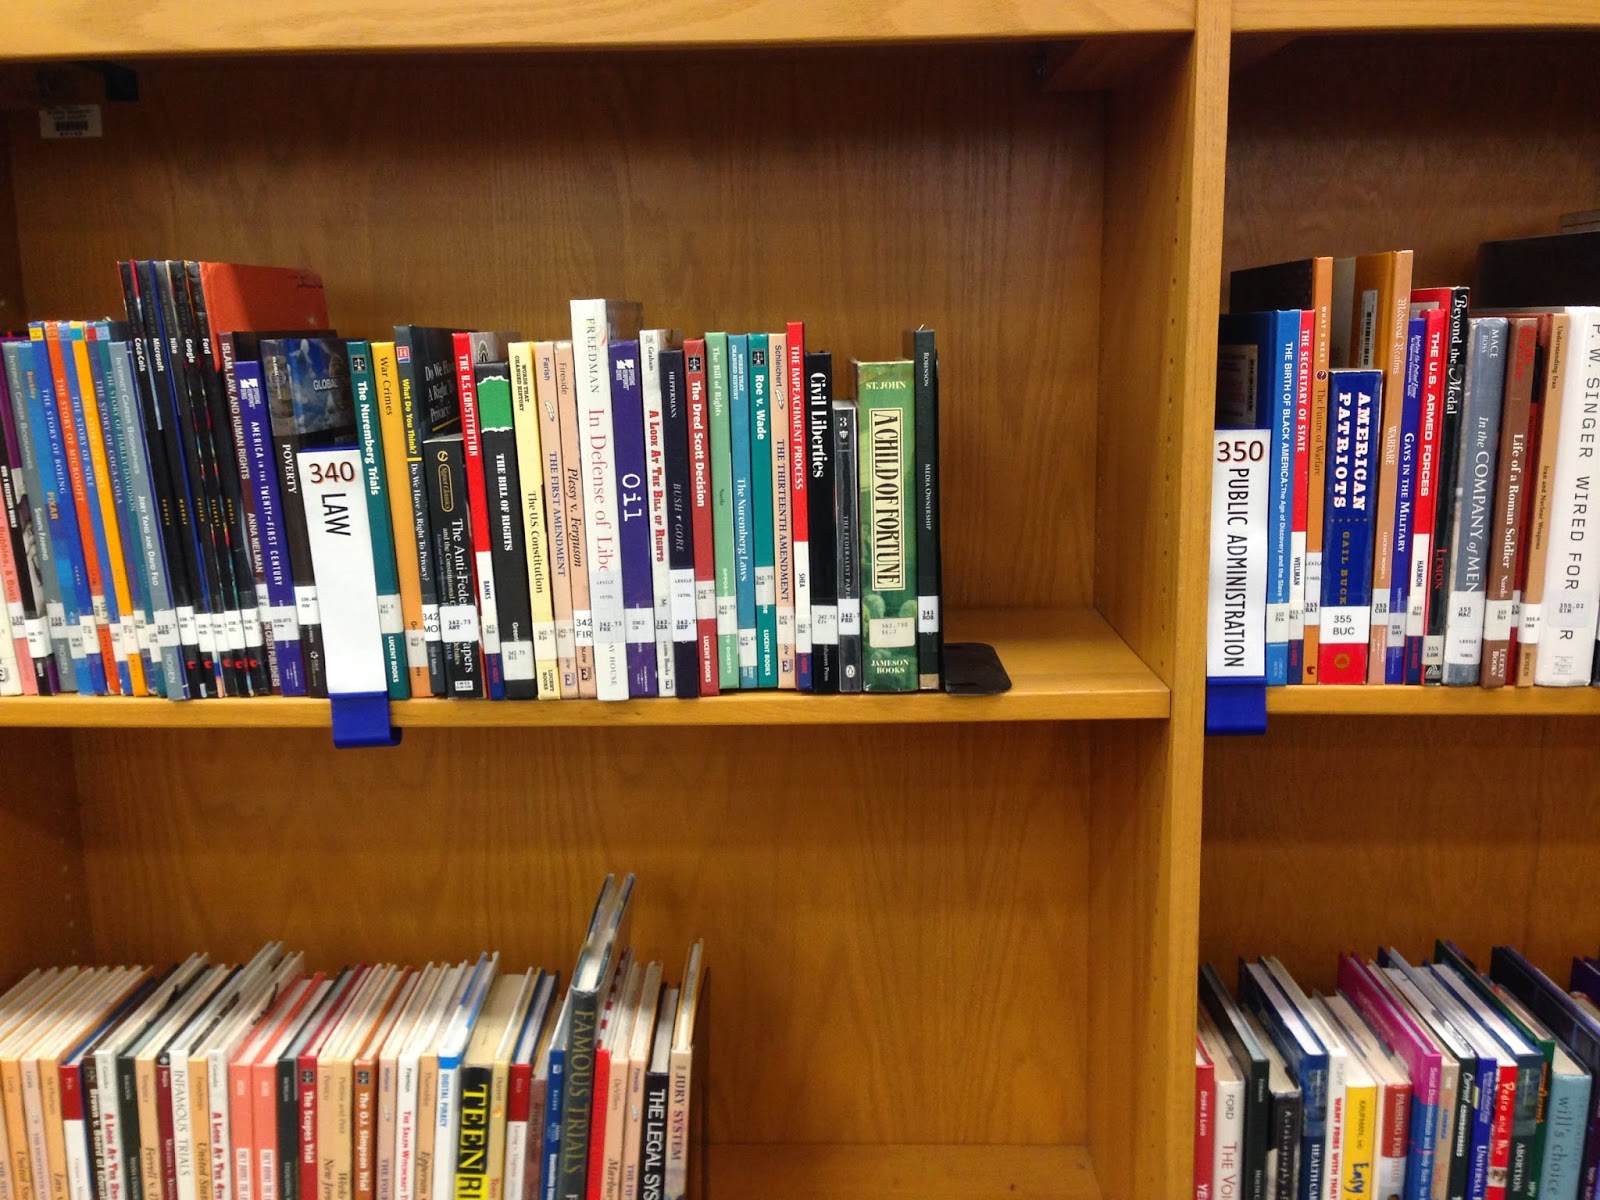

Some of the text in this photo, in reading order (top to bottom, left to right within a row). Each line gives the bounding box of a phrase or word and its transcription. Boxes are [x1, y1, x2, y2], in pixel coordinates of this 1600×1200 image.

[153, 338, 164, 372] Microsoft
[185, 339, 195, 363] Google
[202, 338, 211, 354] Ford
[587, 318, 599, 393] FREEDMAN
[1446, 295, 1468, 415] Beyond the Medal
[1490, 329, 1498, 358] MACE
[380, 356, 393, 416] War Crimes
[402, 379, 411, 400] What
[559, 362, 567, 395] Fireside
[755, 375, 765, 396] Roe
[866, 381, 906, 390] ST. JOHN
[1297, 329, 1310, 452] THE SECRETARY OF STATE
[221, 342, 250, 480] ISLAM, LAW, AND HUMAN RIGHTS
[404, 401, 411, 412] Do
[459, 354, 478, 456] THE U.S. CONSTITUTION
[756, 410, 767, 440] Wade
[791, 346, 803, 490] THE IMPEACHMENT PROCESS
[810, 372, 828, 478] Civil Liberties
[1421, 332, 1440, 496] THE U.S. ARMED FORCES
[42, 389, 66, 494] THE STORY OF BOEING
[57, 379, 84, 501] THE STORY OF MICROSOFT
[76, 418, 87, 447] STORY
[82, 449, 90, 461] OF
[358, 381, 380, 495] The Nuremberg Trials
[407, 429, 417, 455] Think?
[692, 381, 706, 507] The Dred Scott Decision
[1217, 440, 1264, 463] 350
[1334, 392, 1351, 508] PATRIOTS
[1352, 392, 1371, 511] AMERICAN
[1512, 434, 1523, 456] Life
[85, 466, 94, 487] NIKE
[282, 444, 297, 494] POVERTY
[309, 461, 355, 484] 340
[1511, 457, 1523, 472] of
[138, 496, 146, 513] JERRY
[320, 493, 351, 536] LAW
[495, 454, 513, 551] THE BILL OF RIGHTS
[549, 452, 566, 577] THE FIRST AMENDMENT
[622, 473, 643, 522] Oil
[874, 413, 900, 584] A CHILD OF FORTUNE
[1397, 432, 1415, 552] GAYS IN THE MILITARY
[1466, 416, 1490, 593] In the COMPANY of MEN
[1506, 485, 1519, 525] Roman
[142, 515, 150, 533] YANG
[248, 512, 263, 572] ANNA MELMAN
[528, 491, 544, 594] The U.S. Constitution
[737, 478, 748, 582] The Nuremberg Laws
[777, 439, 789, 602] THE THIRTEENTH AMENDMENT
[1565, 476, 1590, 590] WIRED FOR
[148, 551, 157, 572] DAVID
[1224, 468, 1250, 668] PUBLIC ADMINISTRATION
[1293, 556, 1301, 586] WELLMAN
[1504, 526, 1515, 568] Soldier
[150, 571, 159, 587] FILO
[1416, 560, 1424, 587] HARMON
[1333, 627, 1355, 635] BUC
[1334, 615, 1352, 623] 355
[165, 653, 176, 684] ROSEN
[388, 636, 399, 683] LUCENT BOOKS
[871, 659, 909, 667] JAMESON
[440, 1073, 449, 1128] DIGITAL PIRACY
[564, 1009, 595, 1174] FAMOUS TRIALS
[1333, 1097, 1342, 1124] WANT
[1500, 1082, 1515, 1111] Pedro
[174, 1070, 190, 1176] INFAMOUS TRIALS
[302, 1091, 314, 1164] The Scopes Trial
[458, 1084, 488, 1172] TEEN
[671, 1075, 686, 1160] JURY SYSTEM
[1498, 1115, 1506, 1133] and
[643, 1089, 667, 1200] THE LEGAL SYS
[1331, 1152, 1339, 1175] WITH
[1547, 1097, 1573, 1195] will's choice
